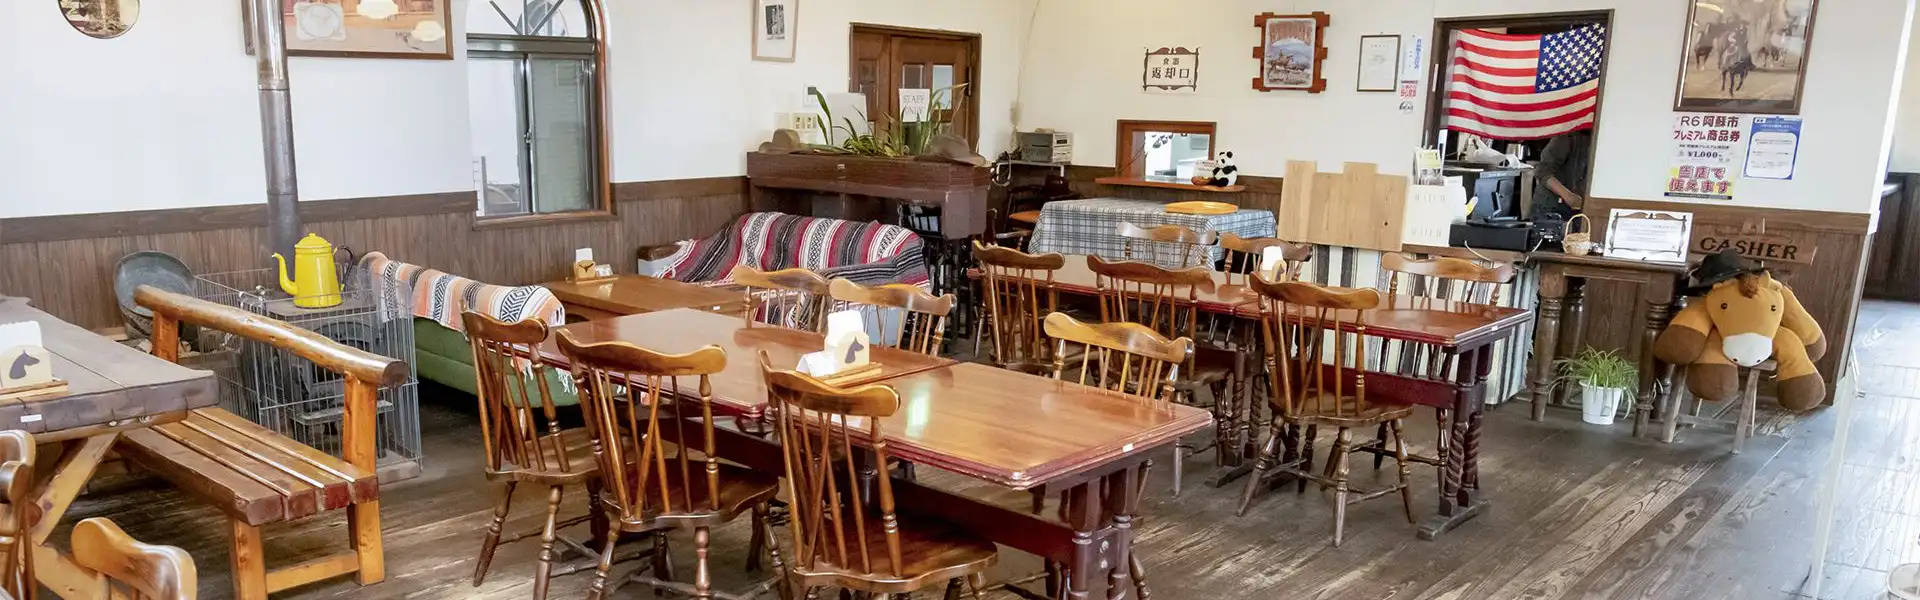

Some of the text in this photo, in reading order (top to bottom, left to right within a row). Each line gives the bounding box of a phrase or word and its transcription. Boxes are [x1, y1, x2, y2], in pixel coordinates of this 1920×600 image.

[1152, 67, 1189, 79] 返却口
[1678, 165, 1725, 179] 当店で
[1669, 178, 1729, 193] 使えます
[1700, 237, 1797, 260] CASHER
